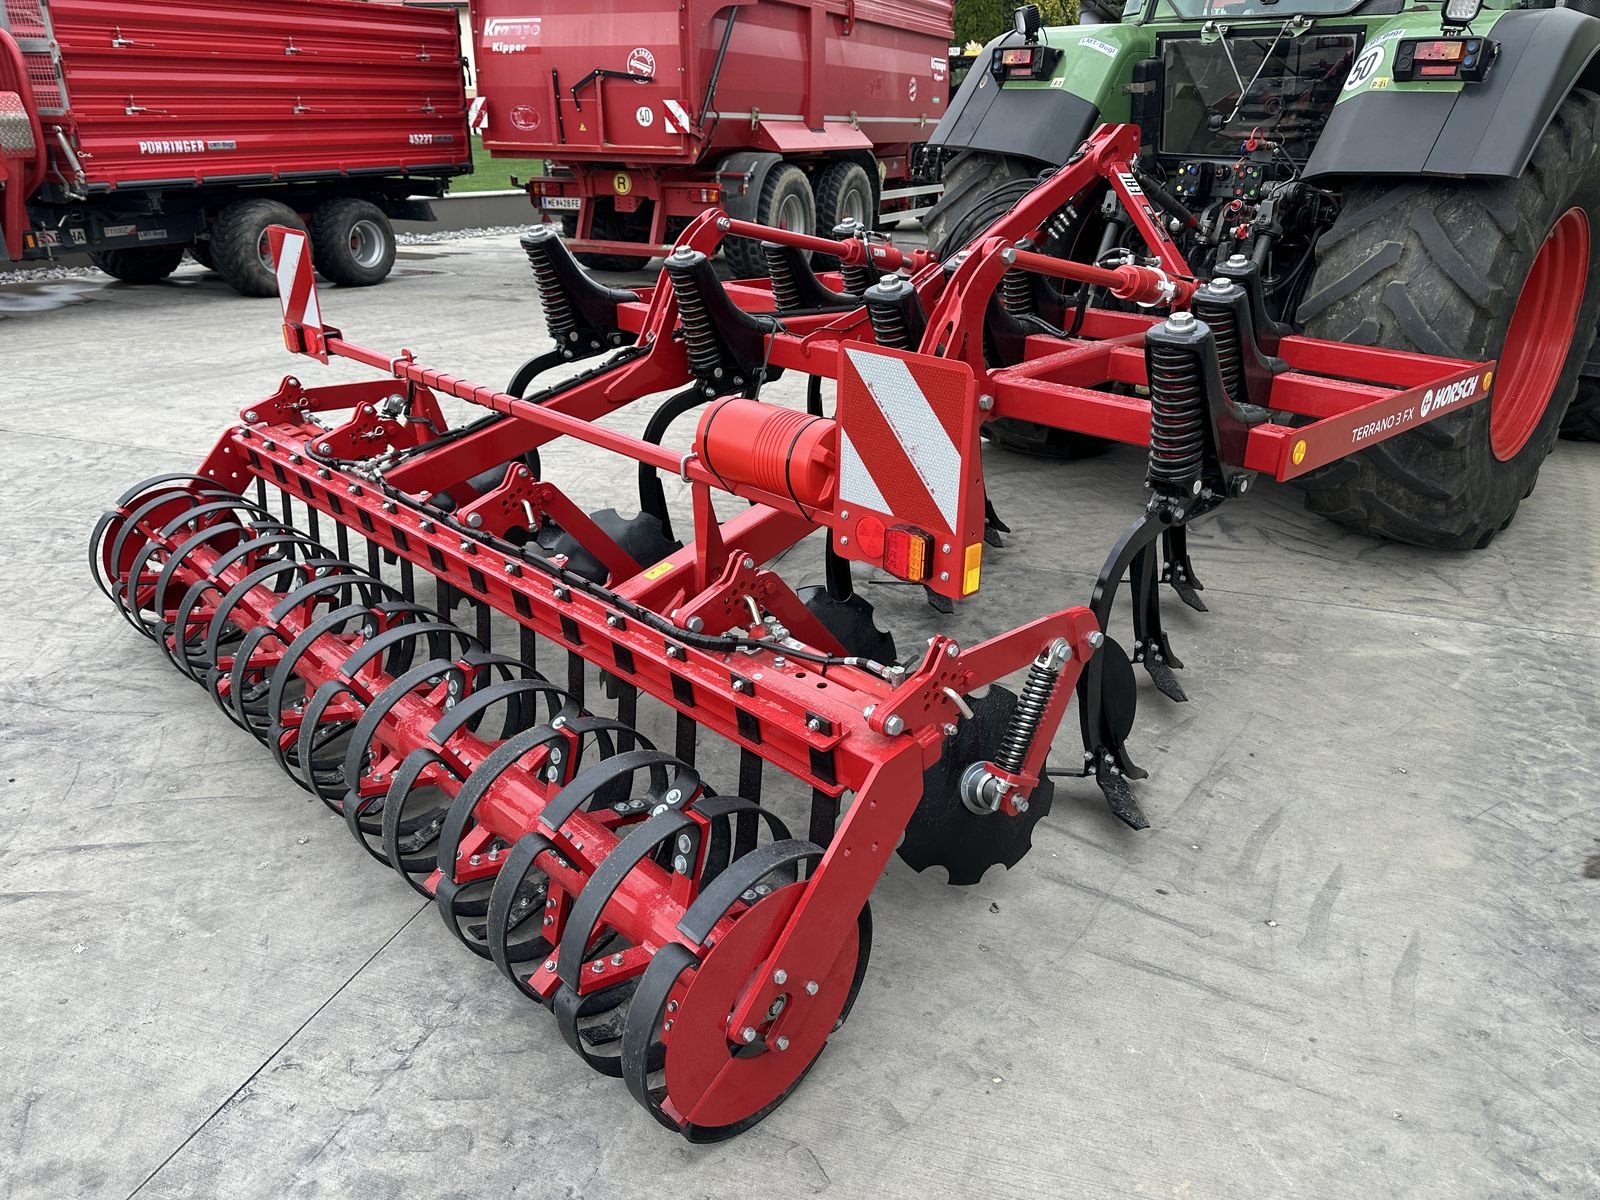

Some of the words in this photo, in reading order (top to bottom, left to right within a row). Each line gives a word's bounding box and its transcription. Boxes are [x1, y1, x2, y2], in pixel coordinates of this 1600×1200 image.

[492, 41, 527, 54] Kipper
[1348, 52, 1378, 85] 50
[639, 109, 650, 122] 40
[617, 176, 626, 190] R
[1351, 415, 1394, 443] TERRANO
[1395, 412, 1400, 426] 3
[1402, 406, 1415, 423] FX
[1432, 375, 1479, 410] HORSCH
